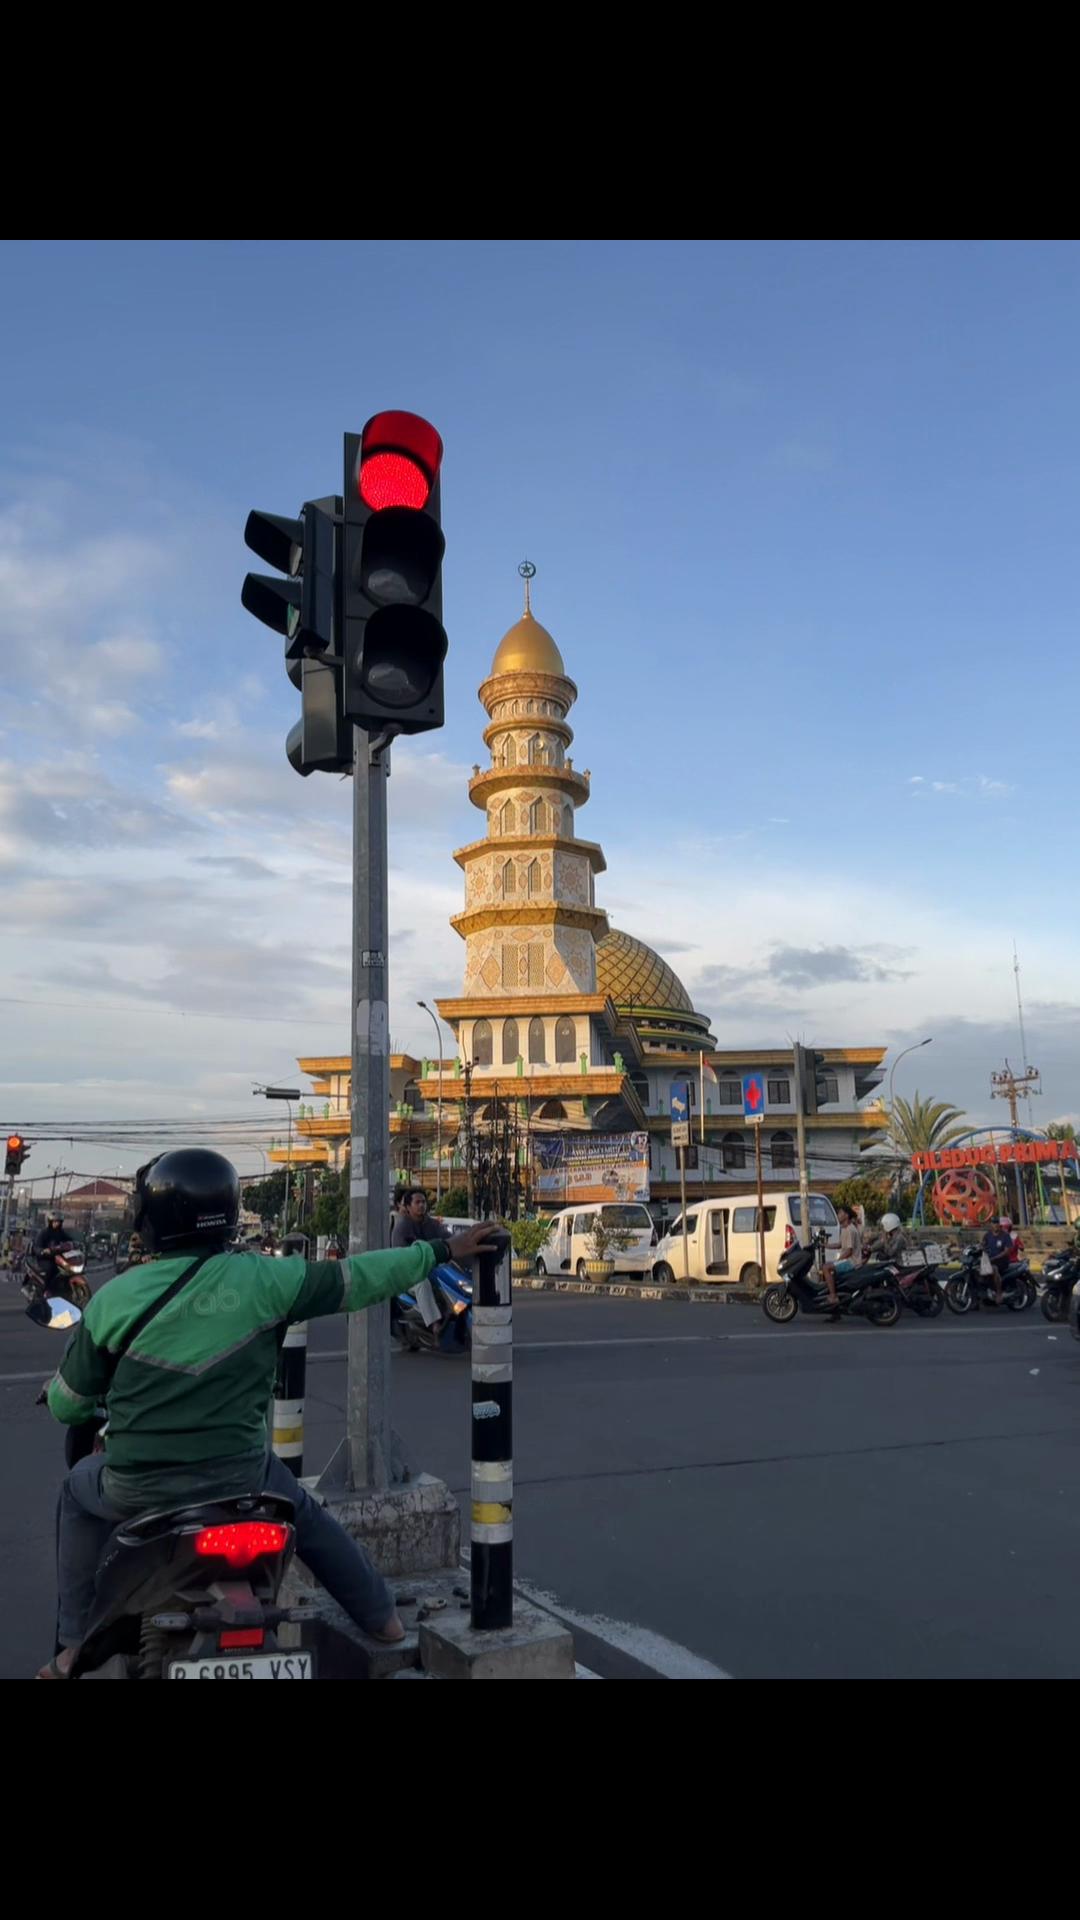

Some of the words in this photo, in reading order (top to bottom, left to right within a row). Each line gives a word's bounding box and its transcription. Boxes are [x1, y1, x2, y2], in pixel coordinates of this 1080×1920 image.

[911, 1144, 997, 1170] CILEDUG
[1000, 1140, 1080, 1164] PRIMA
[270, 1659, 308, 1679] VSY
